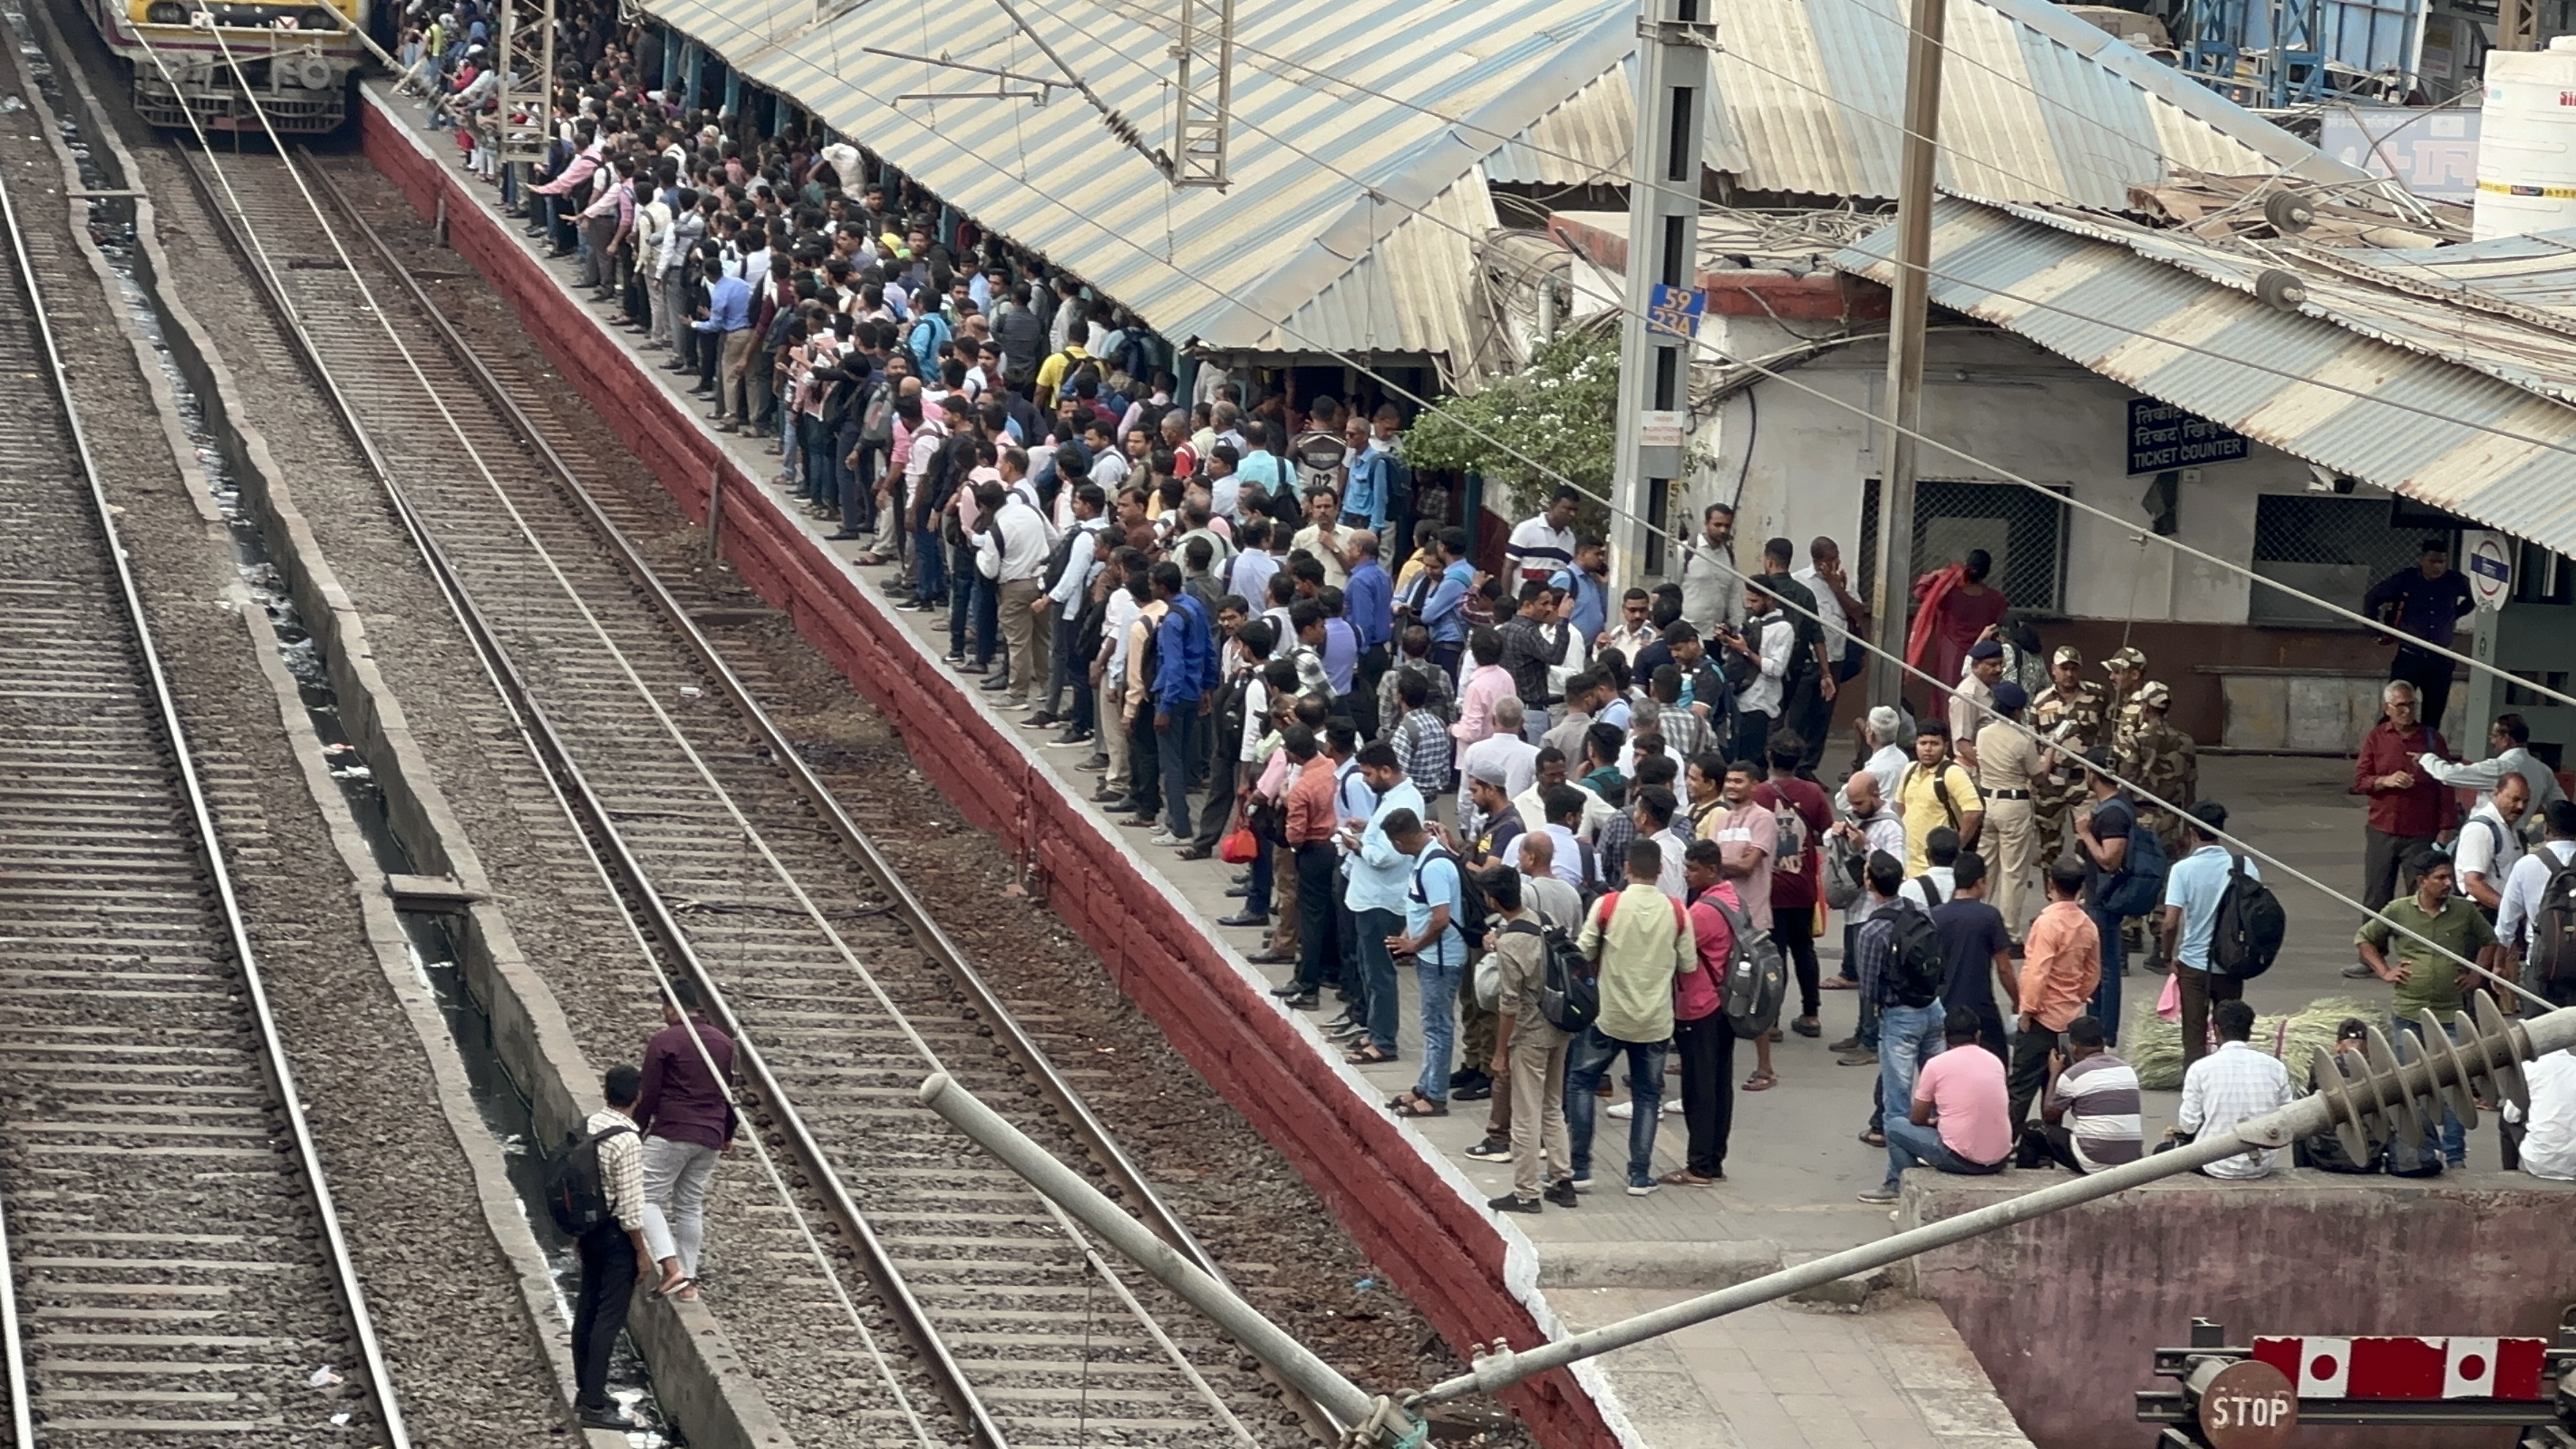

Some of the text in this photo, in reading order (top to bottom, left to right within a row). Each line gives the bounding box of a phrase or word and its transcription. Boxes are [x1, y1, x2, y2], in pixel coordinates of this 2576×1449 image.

[2559, 91, 2576, 107] Si
[1663, 288, 1692, 311] 59
[2135, 426, 2179, 446] टिकट
[2133, 438, 2242, 468] TICKET COUNTER
[1312, 473, 1332, 487] 02
[2212, 1396, 2289, 1427] STOP
